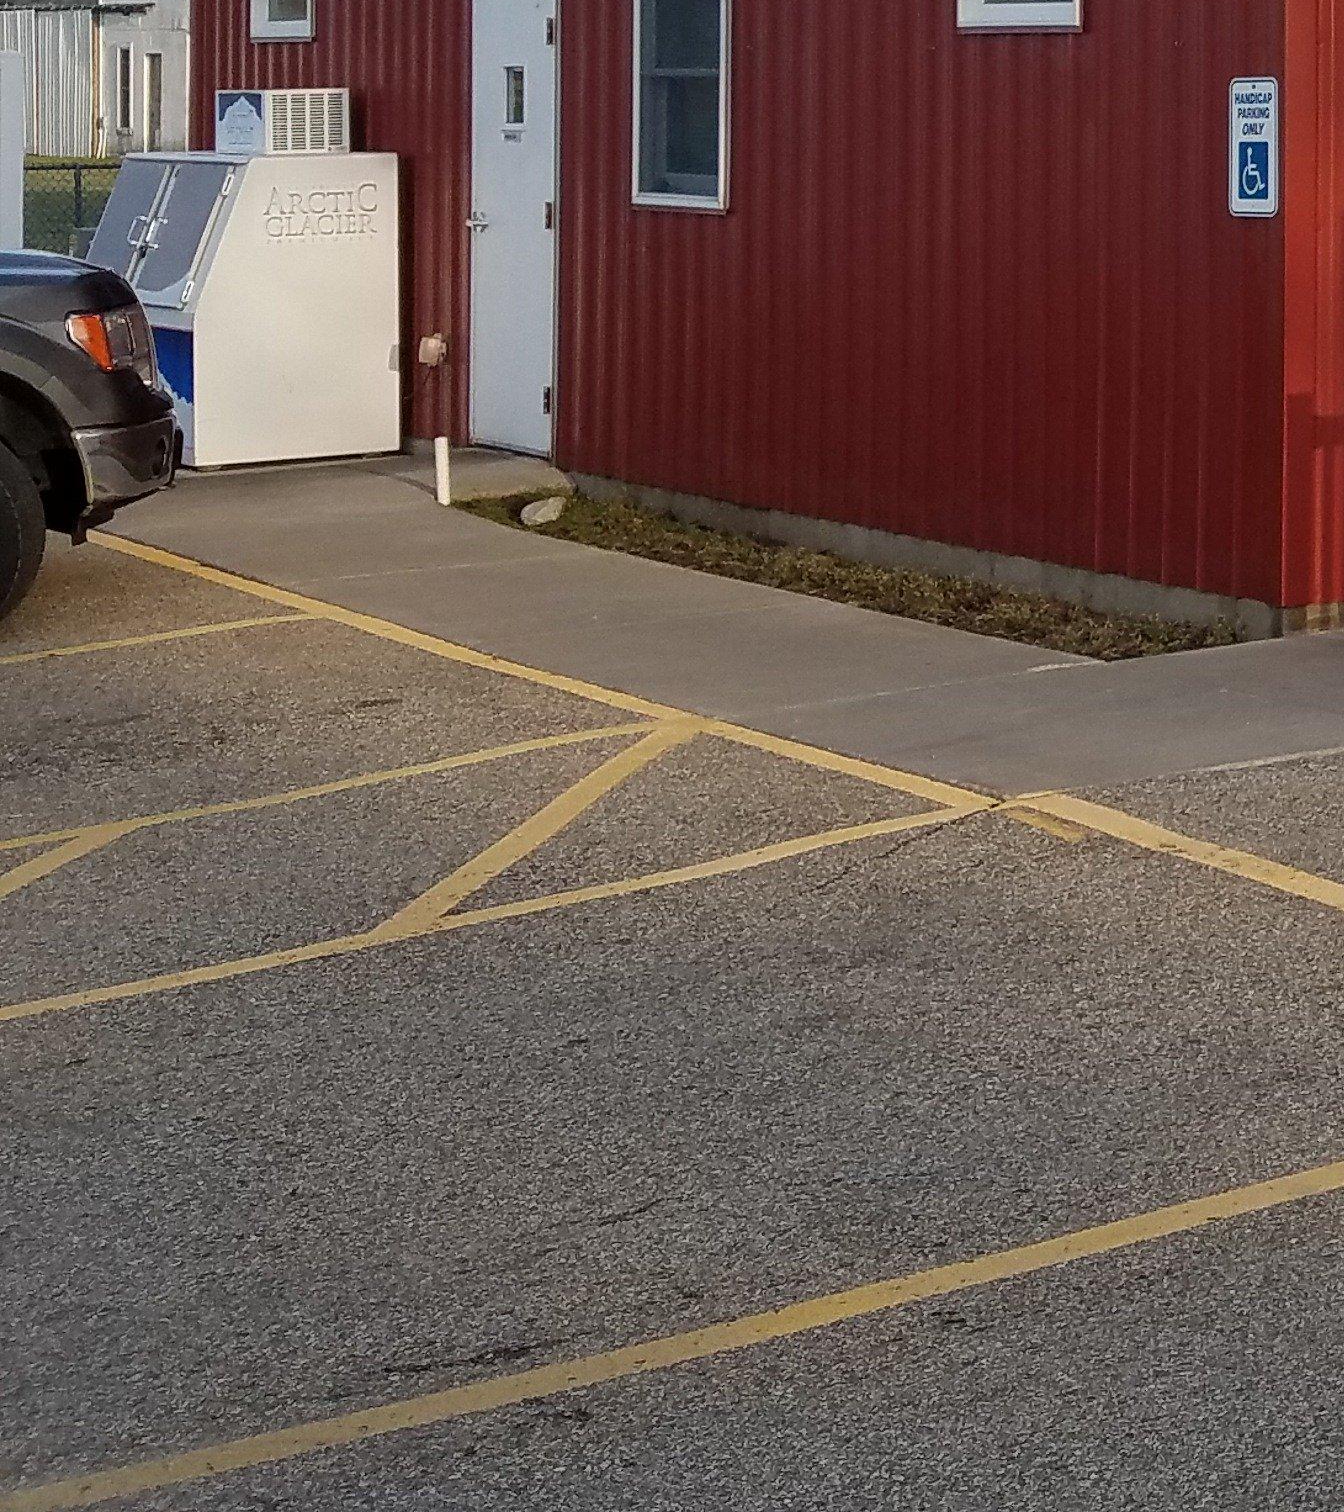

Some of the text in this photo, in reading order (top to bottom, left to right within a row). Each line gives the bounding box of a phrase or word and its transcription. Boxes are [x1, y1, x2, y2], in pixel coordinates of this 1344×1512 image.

[1235, 93, 1272, 104] HANDICAP
[1238, 108, 1269, 118] PARKING
[1242, 123, 1264, 135] ONLY
[263, 183, 377, 215] ARCTIC
[265, 213, 378, 238] GLACIER
